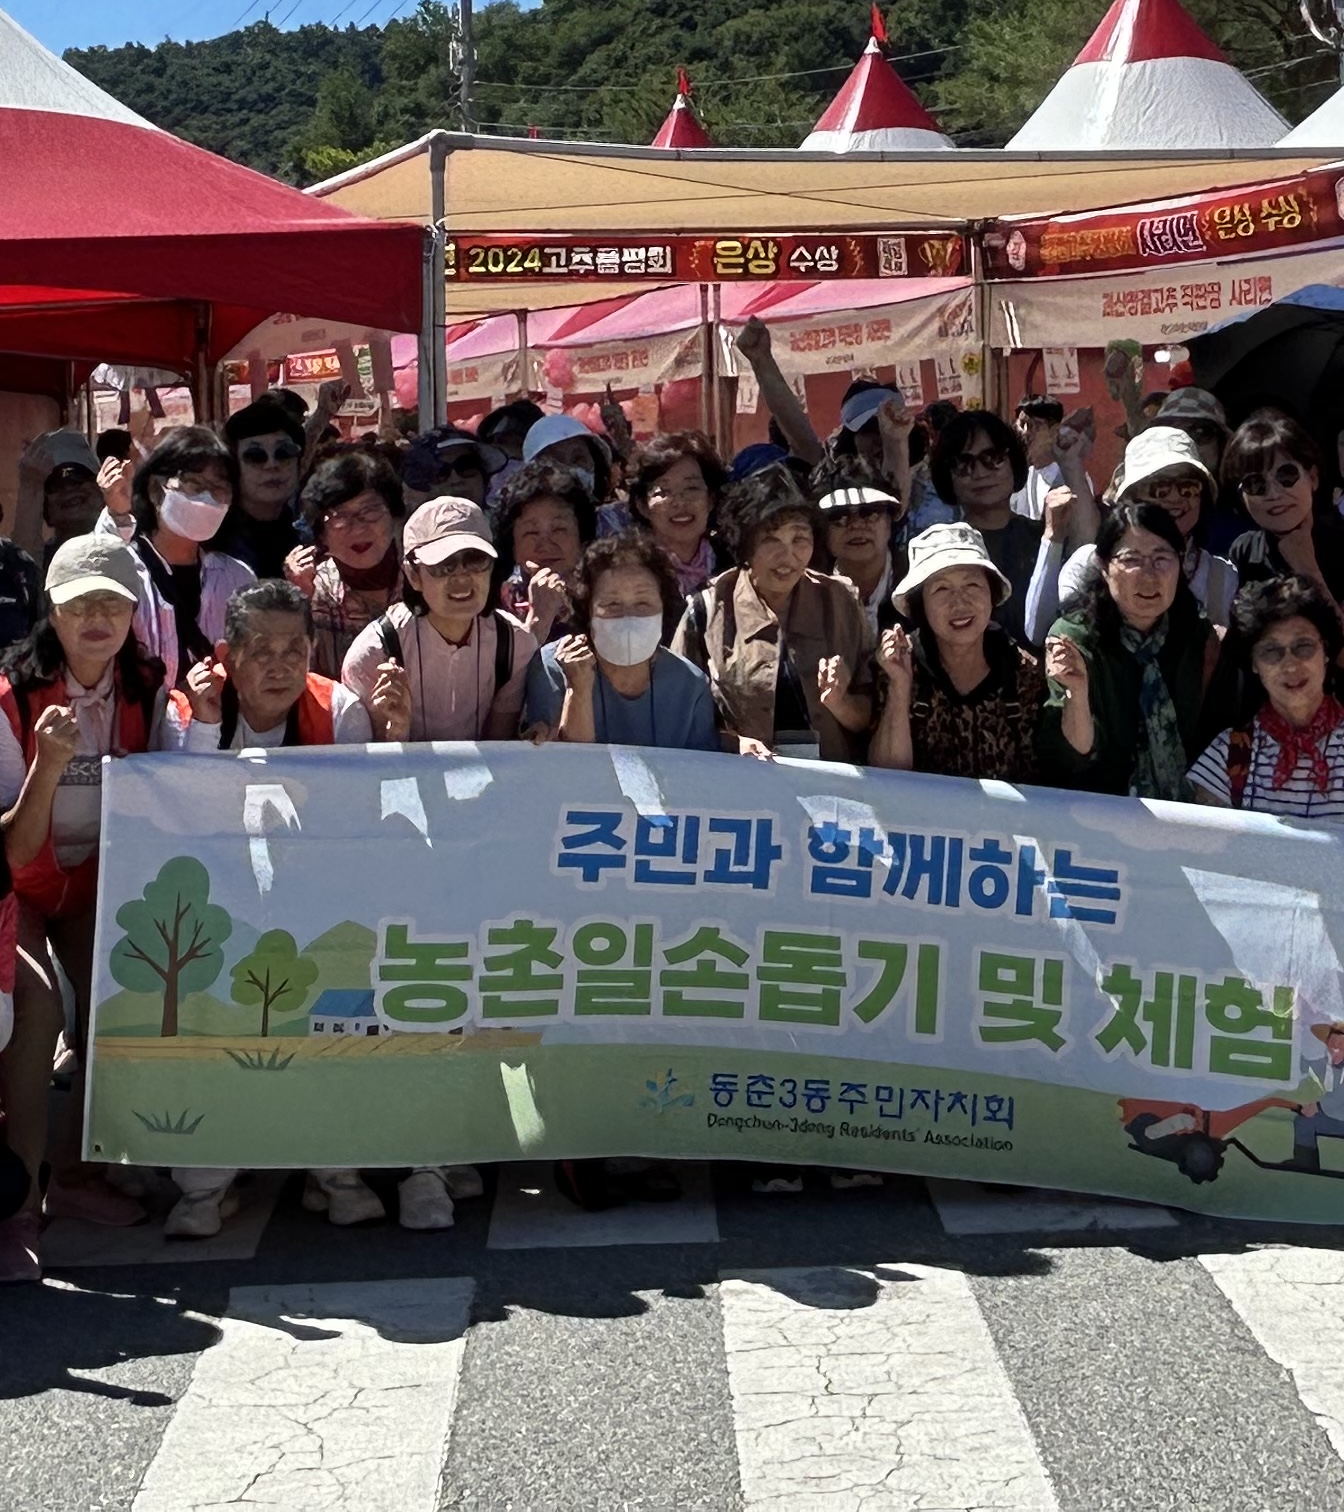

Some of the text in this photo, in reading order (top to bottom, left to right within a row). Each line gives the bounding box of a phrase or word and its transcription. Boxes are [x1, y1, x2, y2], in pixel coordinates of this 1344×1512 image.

[713, 240, 779, 275] 은상
[789, 245, 839, 273] 수상
[558, 808, 1120, 924] 주민과 함께하는
[378, 919, 1296, 1081] 농촌일손돕기 및 체험
[709, 1072, 1015, 1130] 동춘3동주민자치회
[924, 1131, 1014, 1152] Association
